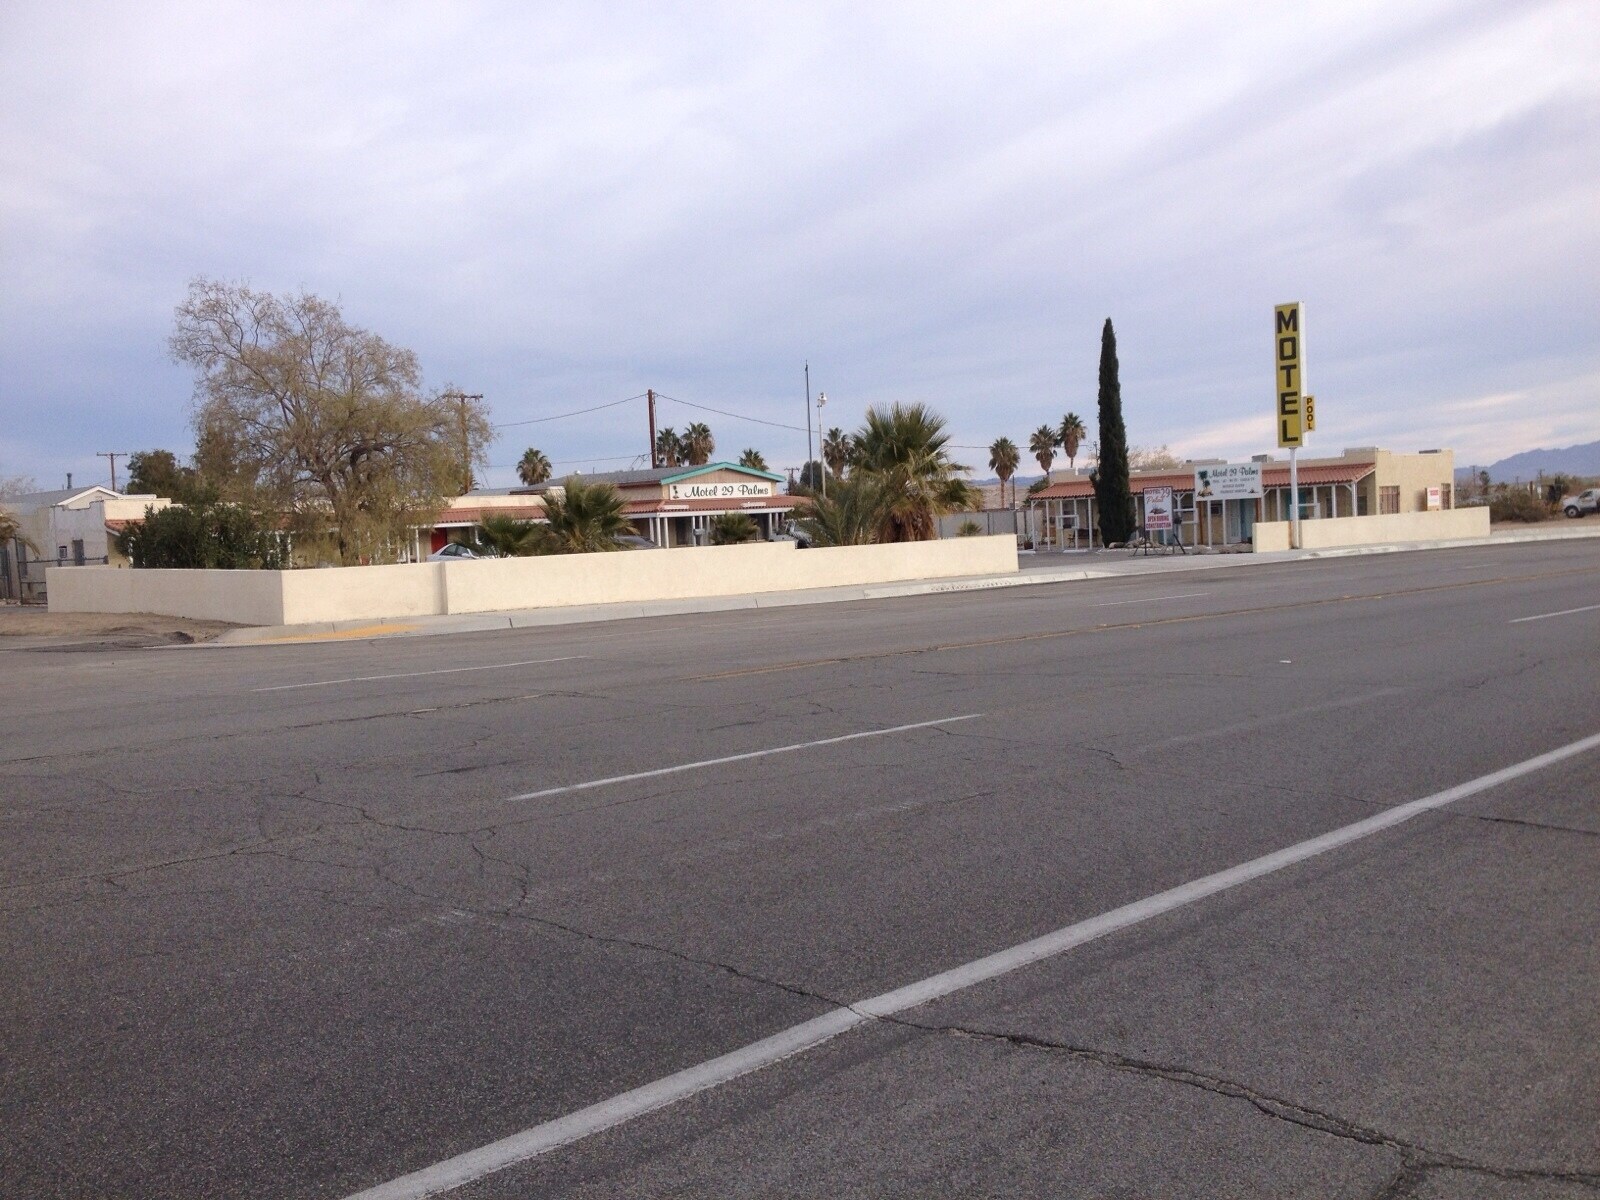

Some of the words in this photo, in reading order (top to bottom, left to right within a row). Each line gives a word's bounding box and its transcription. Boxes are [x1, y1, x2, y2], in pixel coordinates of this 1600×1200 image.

[1277, 309, 1298, 442] MOTEL
[1208, 469, 1228, 478] Motel
[1229, 468, 1238, 477] 29
[1239, 467, 1258, 476] Palms
[684, 485, 718, 498] Motel
[721, 485, 734, 496] 29
[737, 484, 769, 496] Palms
[1161, 487, 1170, 498] 29
